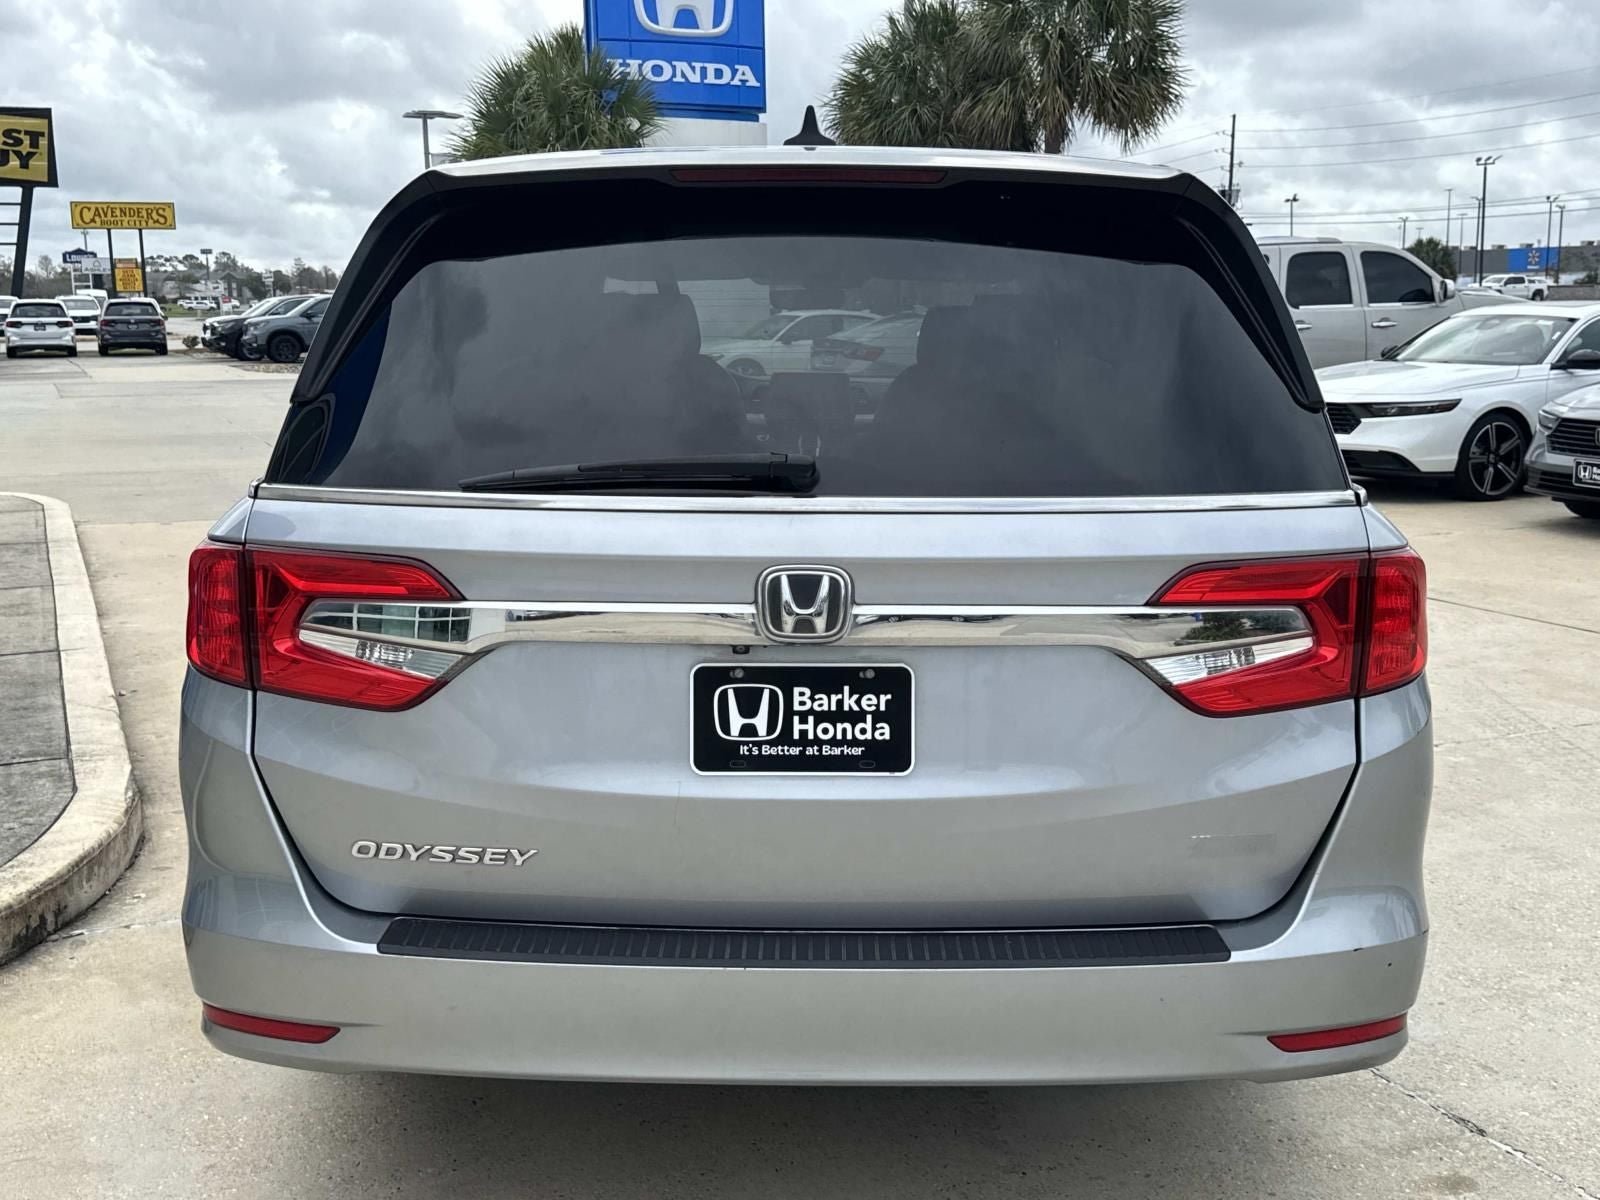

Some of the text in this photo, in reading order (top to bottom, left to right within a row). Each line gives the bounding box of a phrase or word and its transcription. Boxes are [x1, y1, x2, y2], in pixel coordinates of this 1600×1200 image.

[606, 58, 761, 87] HONDA
[79, 205, 169, 226] CAVENDER'S
[127, 219, 150, 227] CITY
[792, 686, 892, 712] Barker
[792, 714, 891, 740] Honda
[739, 743, 865, 756] It's Better at Barker
[351, 840, 539, 866] ODYSSEY
